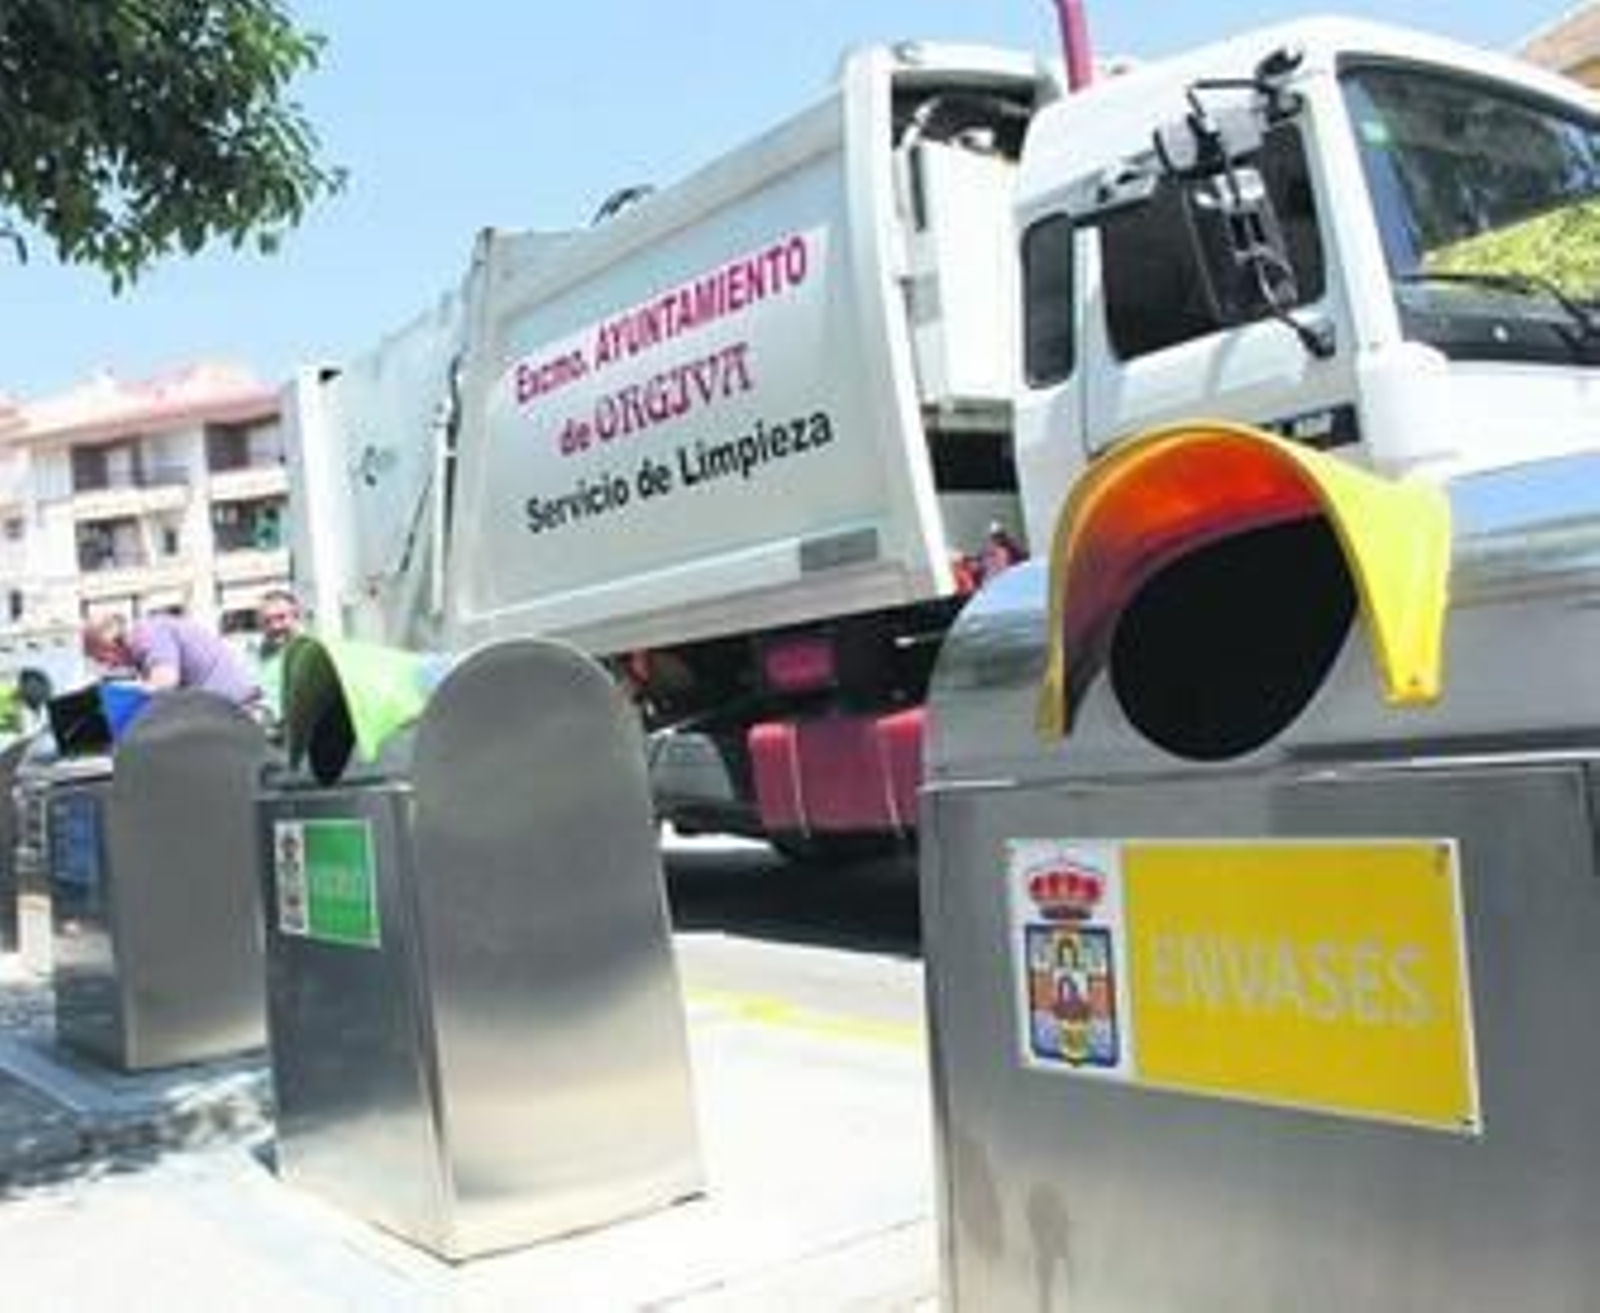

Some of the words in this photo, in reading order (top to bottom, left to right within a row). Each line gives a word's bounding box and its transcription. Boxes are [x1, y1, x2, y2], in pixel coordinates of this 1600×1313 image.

[595, 236, 807, 370] AYUNTAMIENTO
[525, 475, 629, 533] Servicio
[635, 456, 672, 499] de
[677, 409, 833, 486] Limpieza
[559, 416, 592, 457] de
[1150, 932, 1434, 1027] ENVASES
